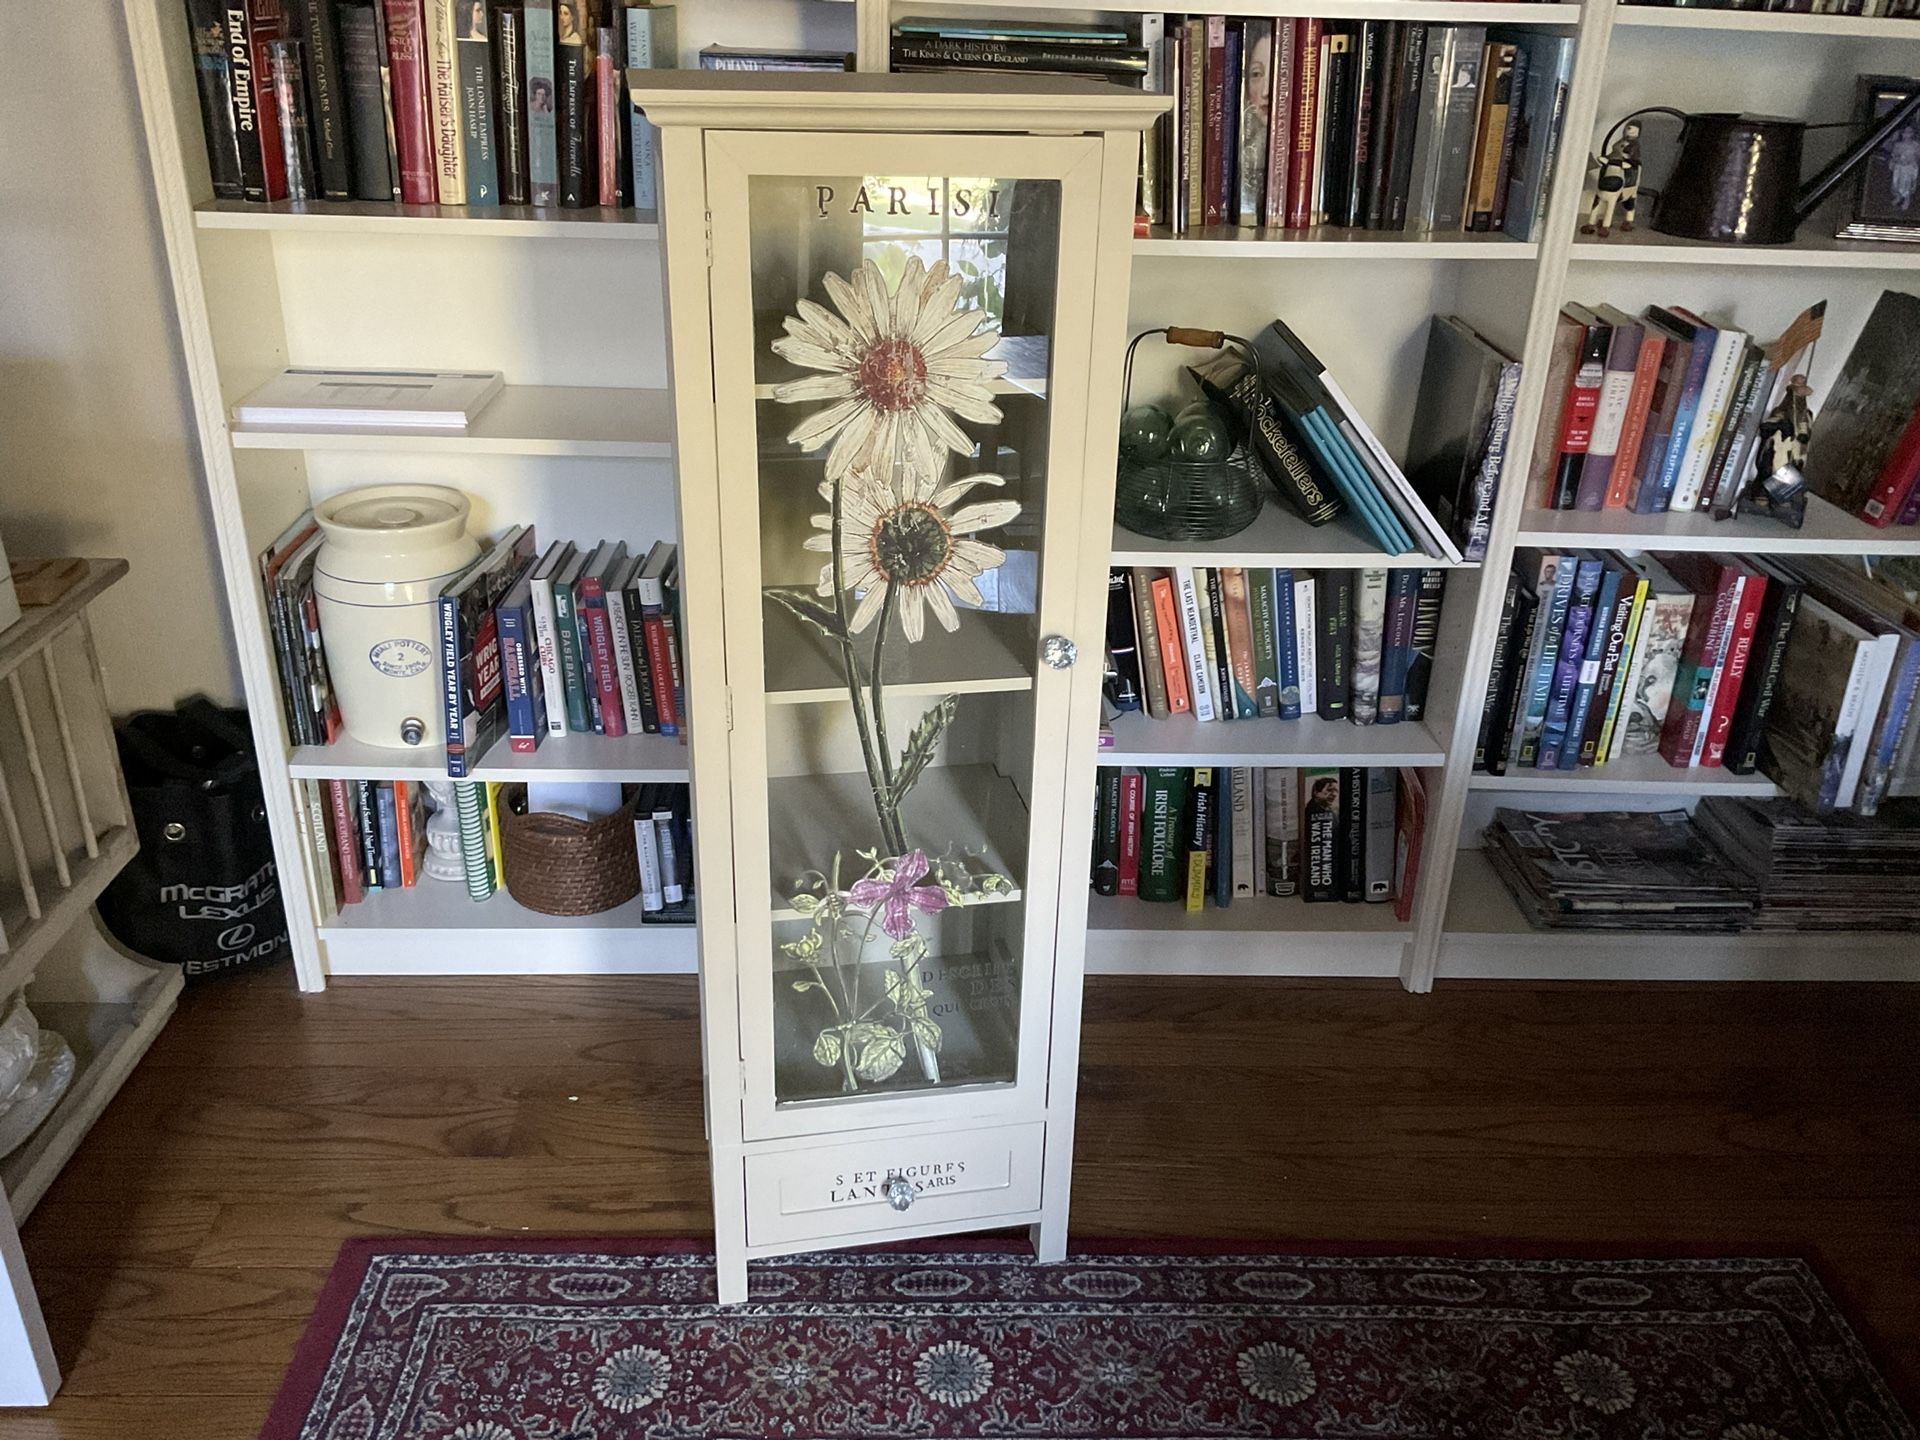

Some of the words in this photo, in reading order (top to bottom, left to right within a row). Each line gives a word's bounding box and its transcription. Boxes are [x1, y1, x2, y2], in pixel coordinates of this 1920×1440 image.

[228, 9, 247, 44] End
[232, 44, 250, 69] of
[903, 48, 918, 58] THE
[919, 49, 942, 59] KINGS
[952, 51, 981, 61] QUEENS
[982, 53, 994, 62] OF
[994, 54, 1029, 64] ENGLAND
[934, 41, 963, 51] DARK
[1365, 32, 1375, 70] WILSON
[437, 60, 452, 79] The
[233, 67, 256, 132] Empire
[315, 63, 330, 112] CAESARS
[477, 84, 486, 119] LONELY
[568, 80, 577, 116] EMPRESS
[1191, 69, 1201, 111] MARRY
[437, 80, 455, 129] Kaiser's
[439, 128, 459, 180] Daughter
[479, 120, 489, 161] EMPRESS
[1190, 121, 1200, 171] ENGLISH
[1357, 115, 1370, 164] TOWER
[568, 136, 583, 178] Farewells
[1190, 173, 1199, 204] LORD
[1727, 400, 1745, 432] Privates
[1662, 420, 1687, 489] TRANSCRIPTION
[1482, 454, 1502, 490] Before
[1479, 489, 1494, 511] and
[1471, 511, 1489, 541] After
[1182, 579, 1191, 591] THE
[1185, 591, 1194, 605] LAST
[1401, 574, 1410, 594] DEAR
[1552, 573, 1574, 625] DRIVES
[1580, 571, 1598, 609] SECRET
[1211, 590, 1220, 617] COLONY
[1260, 584, 1269, 618] MALACHY
[1610, 595, 1634, 633] Visiting
[442, 603, 455, 641] WRIGLEY
[613, 605, 623, 634] SEASON
[1187, 604, 1199, 645] NEANDERTHAL
[1394, 613, 1405, 647] LINCOLN
[1500, 613, 1512, 636] The
[1599, 606, 1609, 630] NORMAN
[1704, 591, 1726, 651] CONCUBINE
[1743, 612, 1755, 629] DID
[1782, 620, 1792, 639] The
[593, 616, 609, 662] WRIGLEY
[617, 634, 625, 643] IN
[619, 643, 627, 656] THE
[1568, 608, 1587, 662] JOURNEYS
[1592, 630, 1605, 657] ROCKWELL
[1609, 630, 1625, 653] Our
[397, 652, 405, 662] 2
[445, 642, 456, 667] FIELD
[515, 643, 526, 676] OBSESSED
[561, 630, 575, 692] BASEBALL
[620, 656, 629, 671] SUN
[631, 619, 643, 647] TALES
[640, 665, 653, 706] DUGOUT
[1193, 653, 1202, 668] CLAIRE
[1494, 635, 1509, 670] Untold
[1604, 649, 1620, 672] Past
[1730, 637, 1750, 679] REALLY
[1769, 638, 1787, 675] Untold
[446, 669, 457, 693] YEAR
[503, 637, 520, 701] BASEBALL
[600, 661, 613, 693] FIELD
[1196, 667, 1206, 695] CAMERON
[1490, 669, 1502, 694] Civil
[1534, 643, 1559, 705] LIFETIME
[448, 693, 457, 705] BY
[623, 673, 634, 700] ROGER
[1558, 675, 1574, 716] LIFETIME
[1763, 674, 1777, 698] Civil
[448, 705, 458, 730] YEAR
[629, 699, 639, 721] KAHN
[1484, 693, 1496, 712] War
[1758, 696, 1772, 718] War
[1573, 717, 1585, 738] CAMERA
[1129, 788, 1137, 811] COURSE
[1154, 789, 1168, 819] IRISH
[1197, 791, 1208, 812] Irish
[1232, 767, 1244, 813] IRELAND
[1351, 774, 1361, 807] HISTORY
[310, 802, 327, 853] SCOTLAND
[363, 811, 373, 834] Scotland
[1128, 811, 1135, 821] OF
[1192, 811, 1206, 847] History
[1321, 821, 1333, 836] THE
[1351, 808, 1361, 822] OF
[339, 818, 350, 854] SCOTLAND
[1151, 818, 1167, 877] FOLKLORE
[1167, 815, 1178, 849] Treasury
[1310, 821, 1321, 844] WAS
[1321, 836, 1333, 858] MAN
[1350, 821, 1361, 855] IRELAND
[1167, 849, 1177, 860] of
[1310, 843, 1321, 887] IRELAND
[1321, 858, 1333, 886] WHO
[178, 882, 277, 921] LEXUS
[182, 930, 289, 976] ESTMON
[854, 1171, 878, 1184] ET
